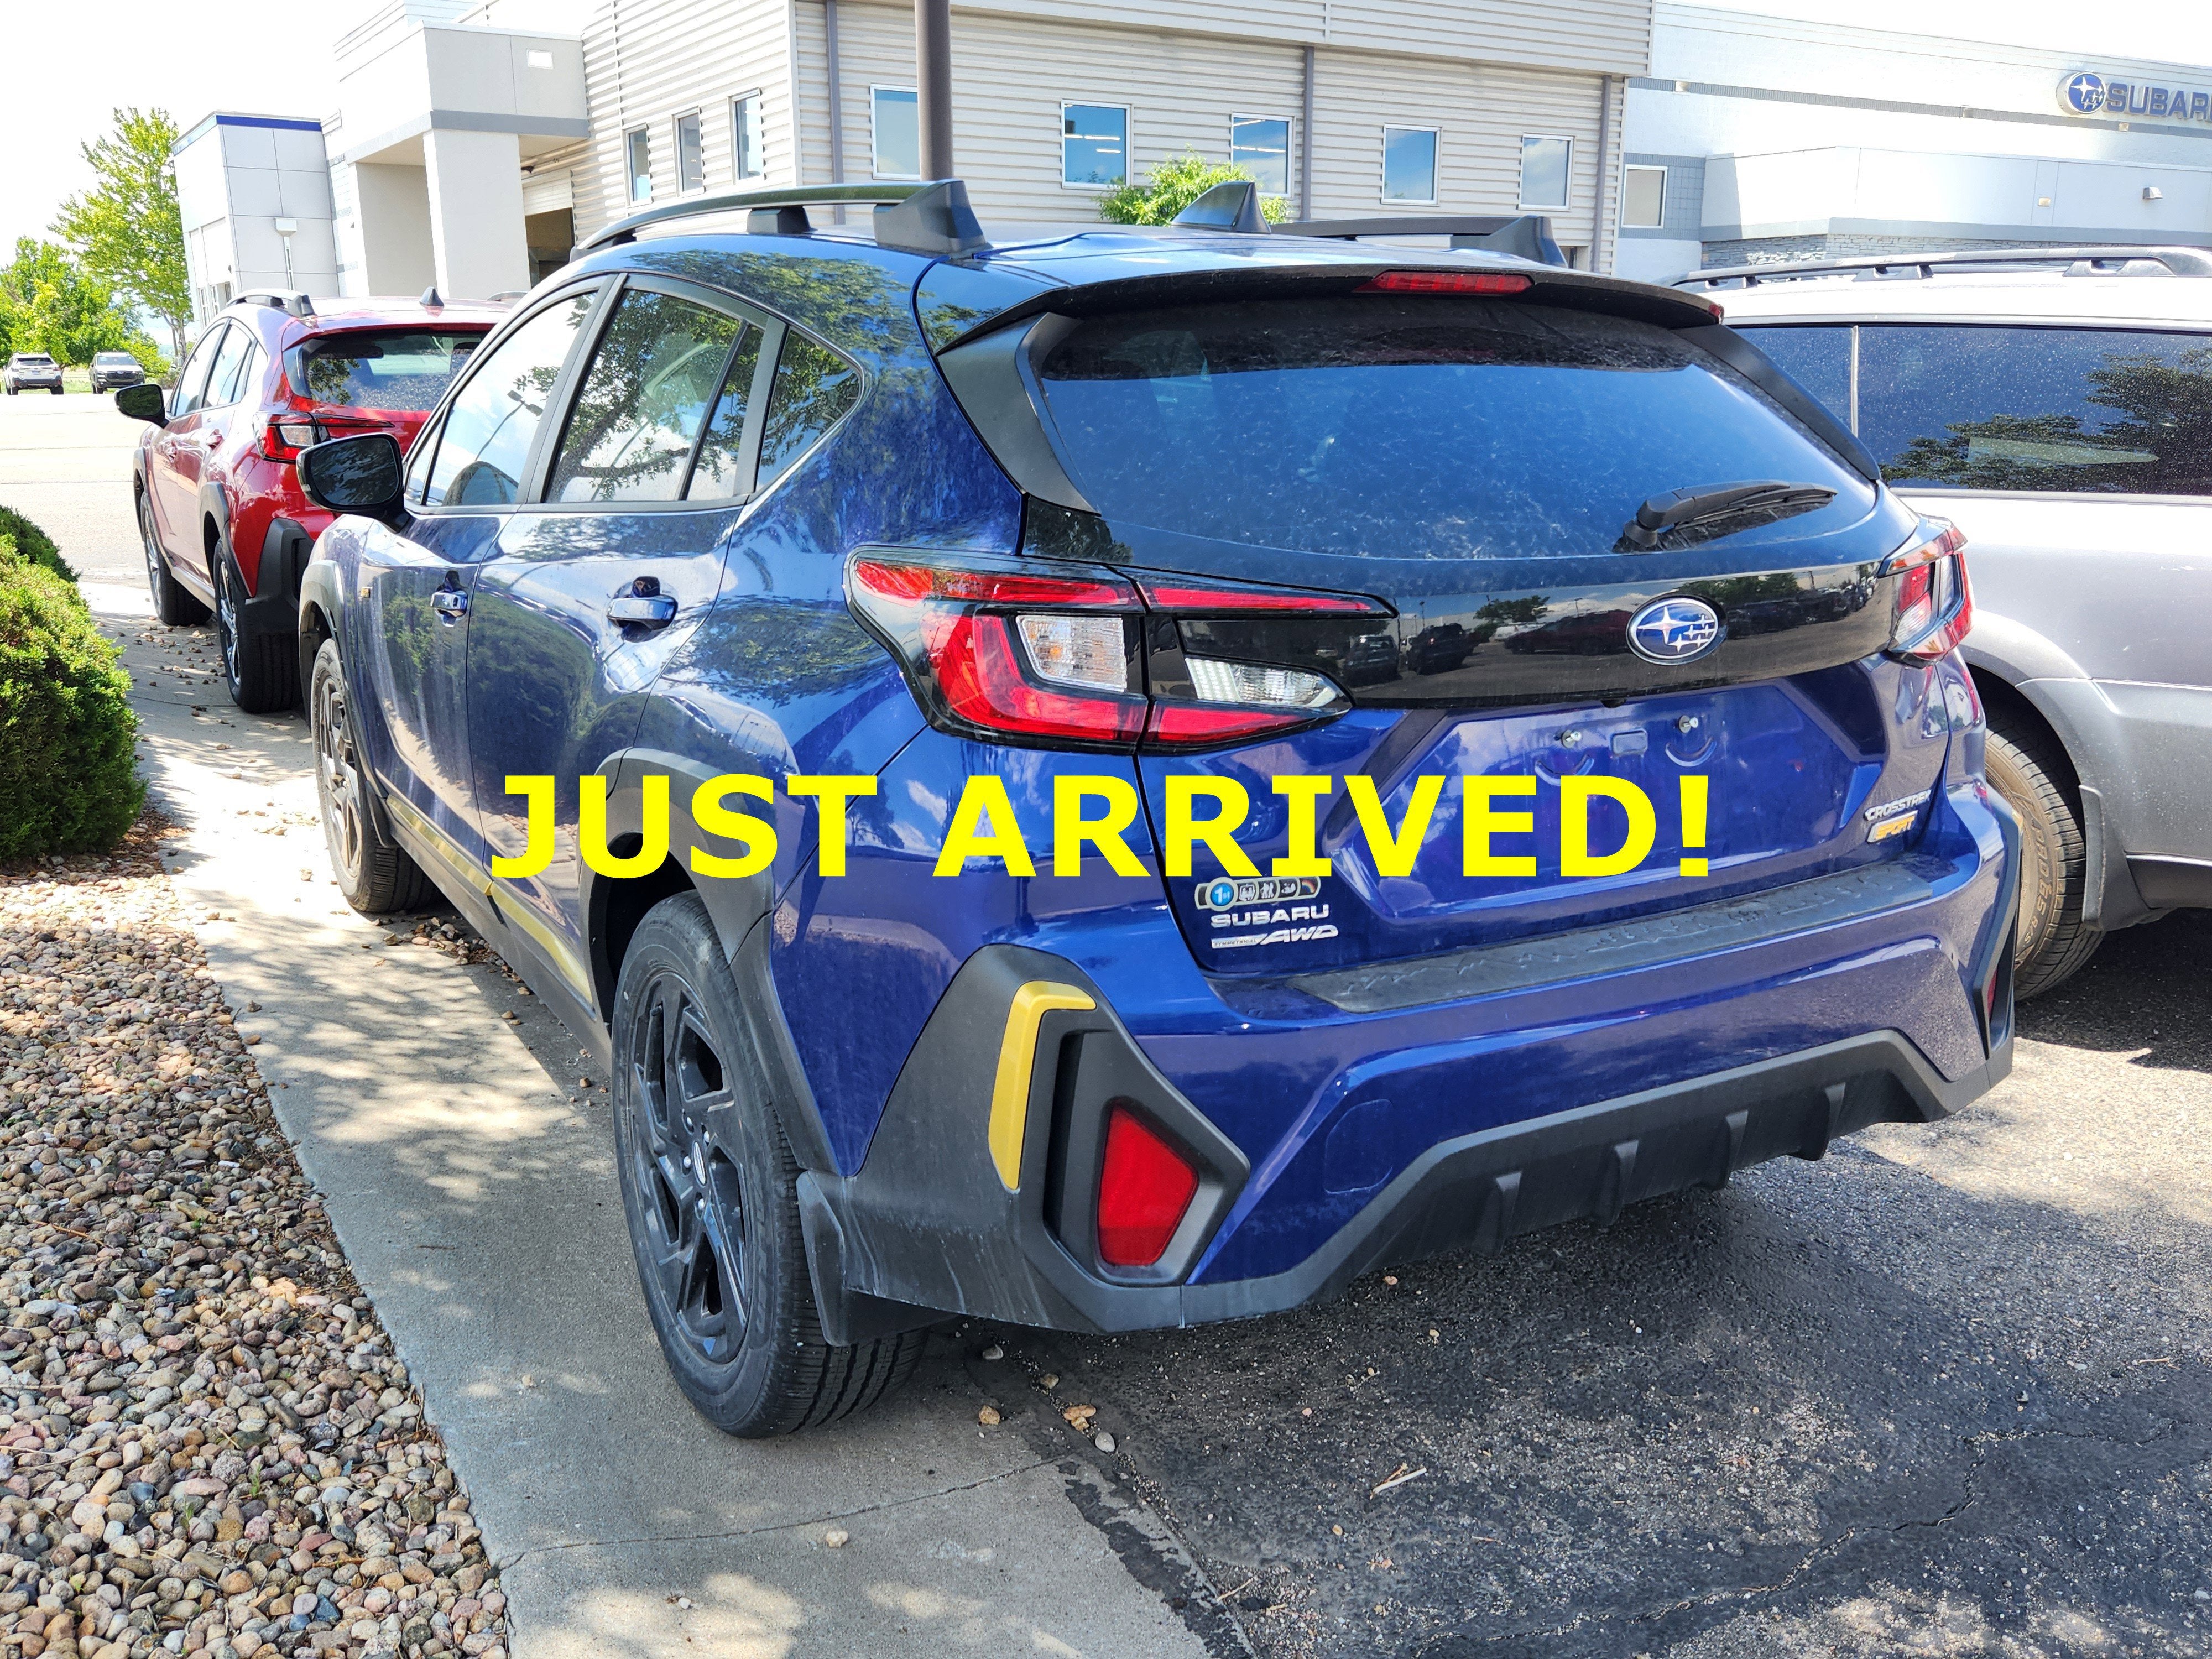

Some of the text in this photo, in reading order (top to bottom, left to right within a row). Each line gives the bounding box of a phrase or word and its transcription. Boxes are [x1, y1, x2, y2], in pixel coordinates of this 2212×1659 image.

[2106, 82, 2212, 120] SUBAR
[1211, 904, 1329, 928] SUBARU
[1260, 925, 1339, 945] AWD
